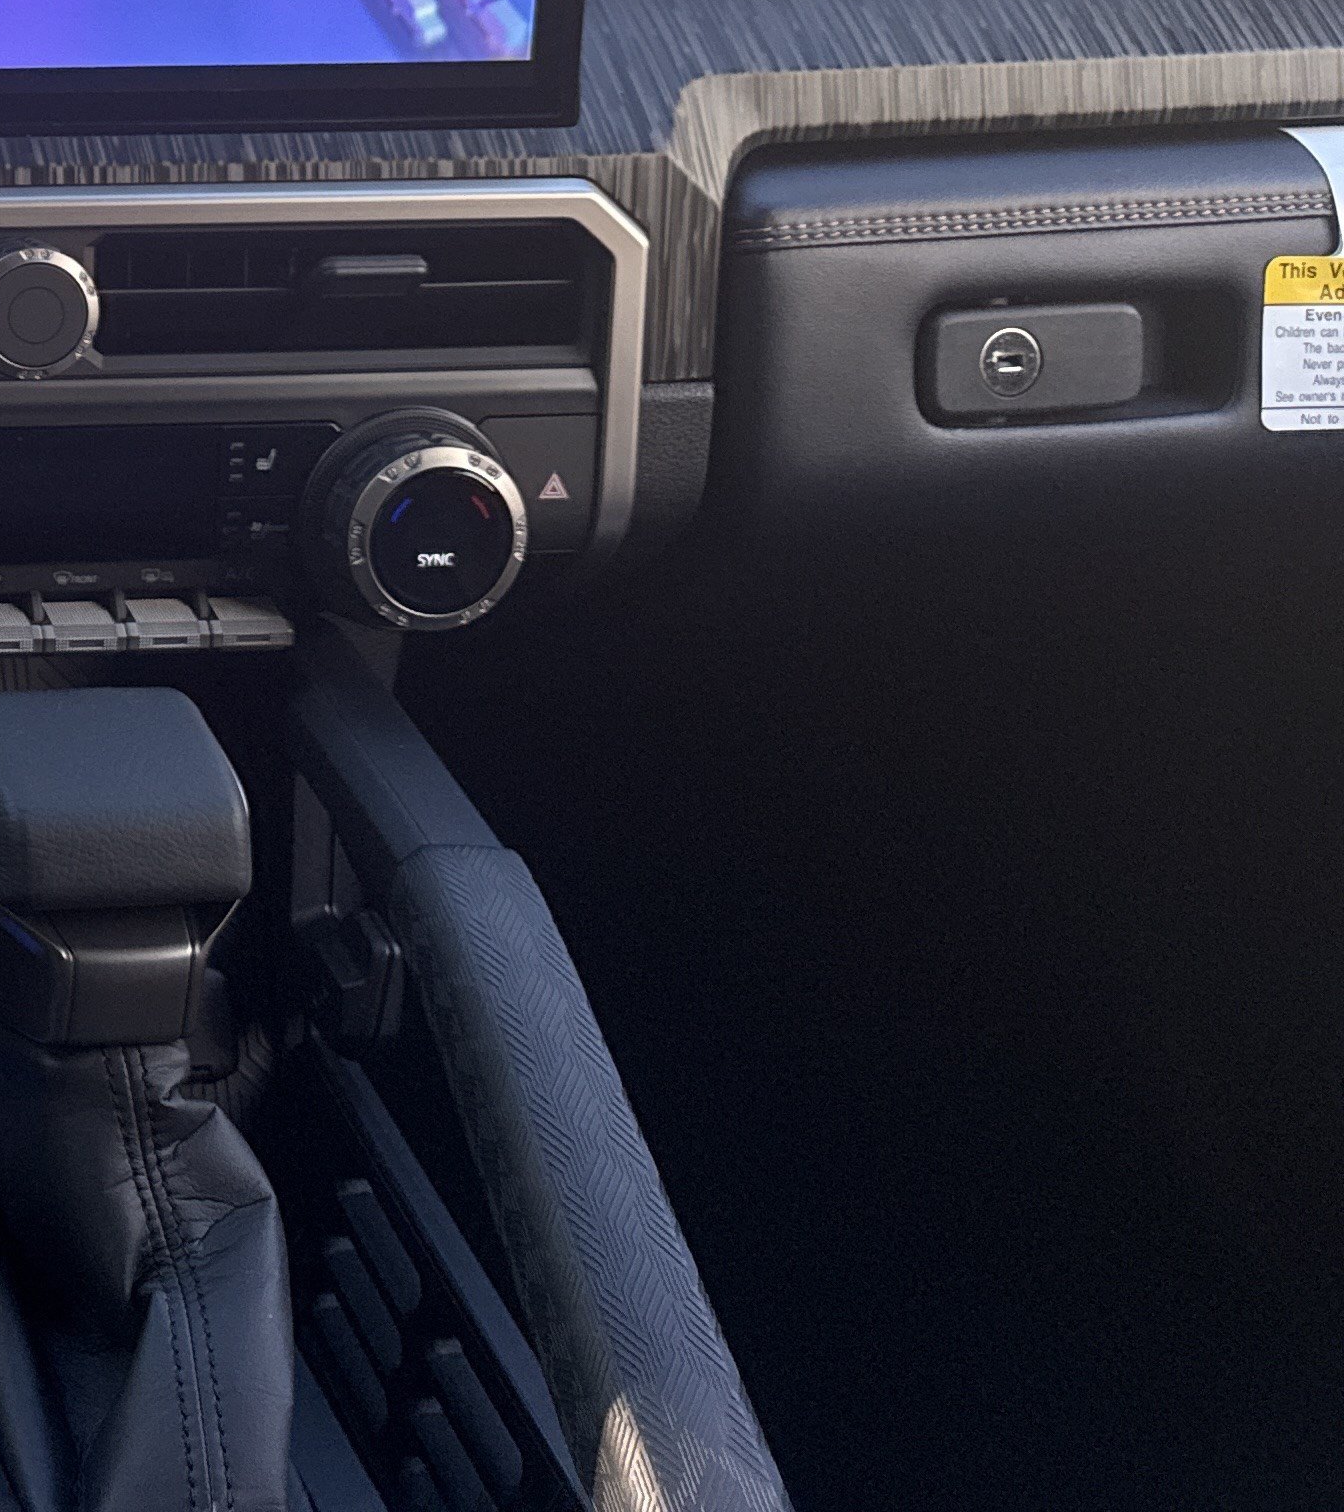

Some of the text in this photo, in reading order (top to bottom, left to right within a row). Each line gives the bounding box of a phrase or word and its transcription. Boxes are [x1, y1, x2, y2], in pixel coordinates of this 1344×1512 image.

[1279, 262, 1317, 279] This
[1305, 309, 1342, 321] Even
[1275, 326, 1339, 338] Children can
[1303, 342, 1322, 354] The
[1302, 358, 1332, 370] Never
[1275, 390, 1336, 402] See owner's
[1300, 413, 1339, 425] Not to
[416, 552, 455, 568] SYNC
